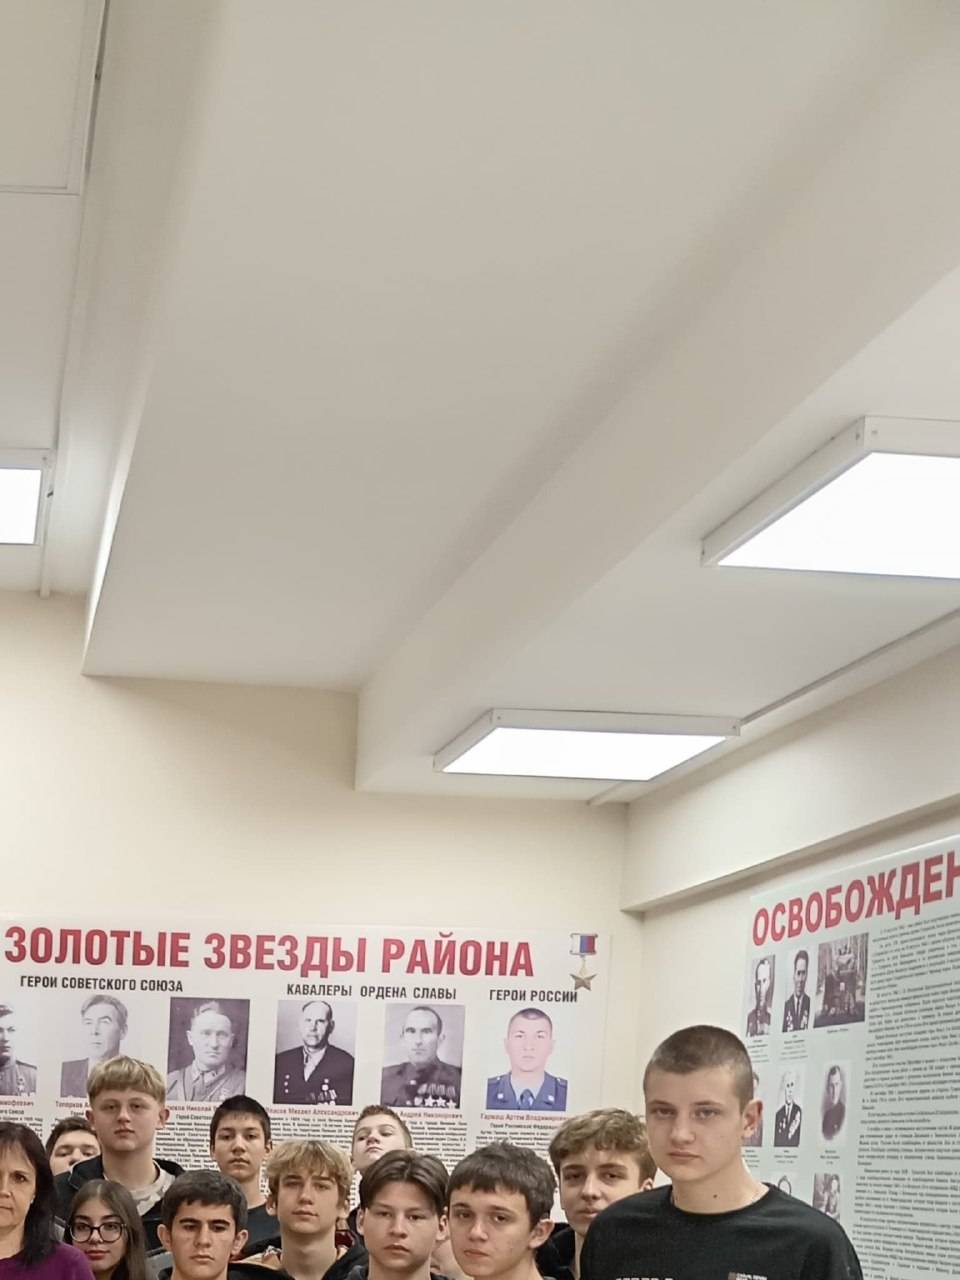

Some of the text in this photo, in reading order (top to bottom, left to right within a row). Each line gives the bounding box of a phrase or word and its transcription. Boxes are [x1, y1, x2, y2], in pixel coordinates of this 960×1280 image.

[4, 926, 534, 978] ЗОЛОТЫЕ ЗВЕЗДЫ РАЙОНА
[20, 975, 184, 993] ГЕРОИ СОВЕТСКОГО СОЮЗА
[287, 983, 457, 1000] КАВАЛЕРЫ ОРДЕНА СЛАВЫ
[489, 989, 578, 1003] ГЕРОИ РОССИИ
